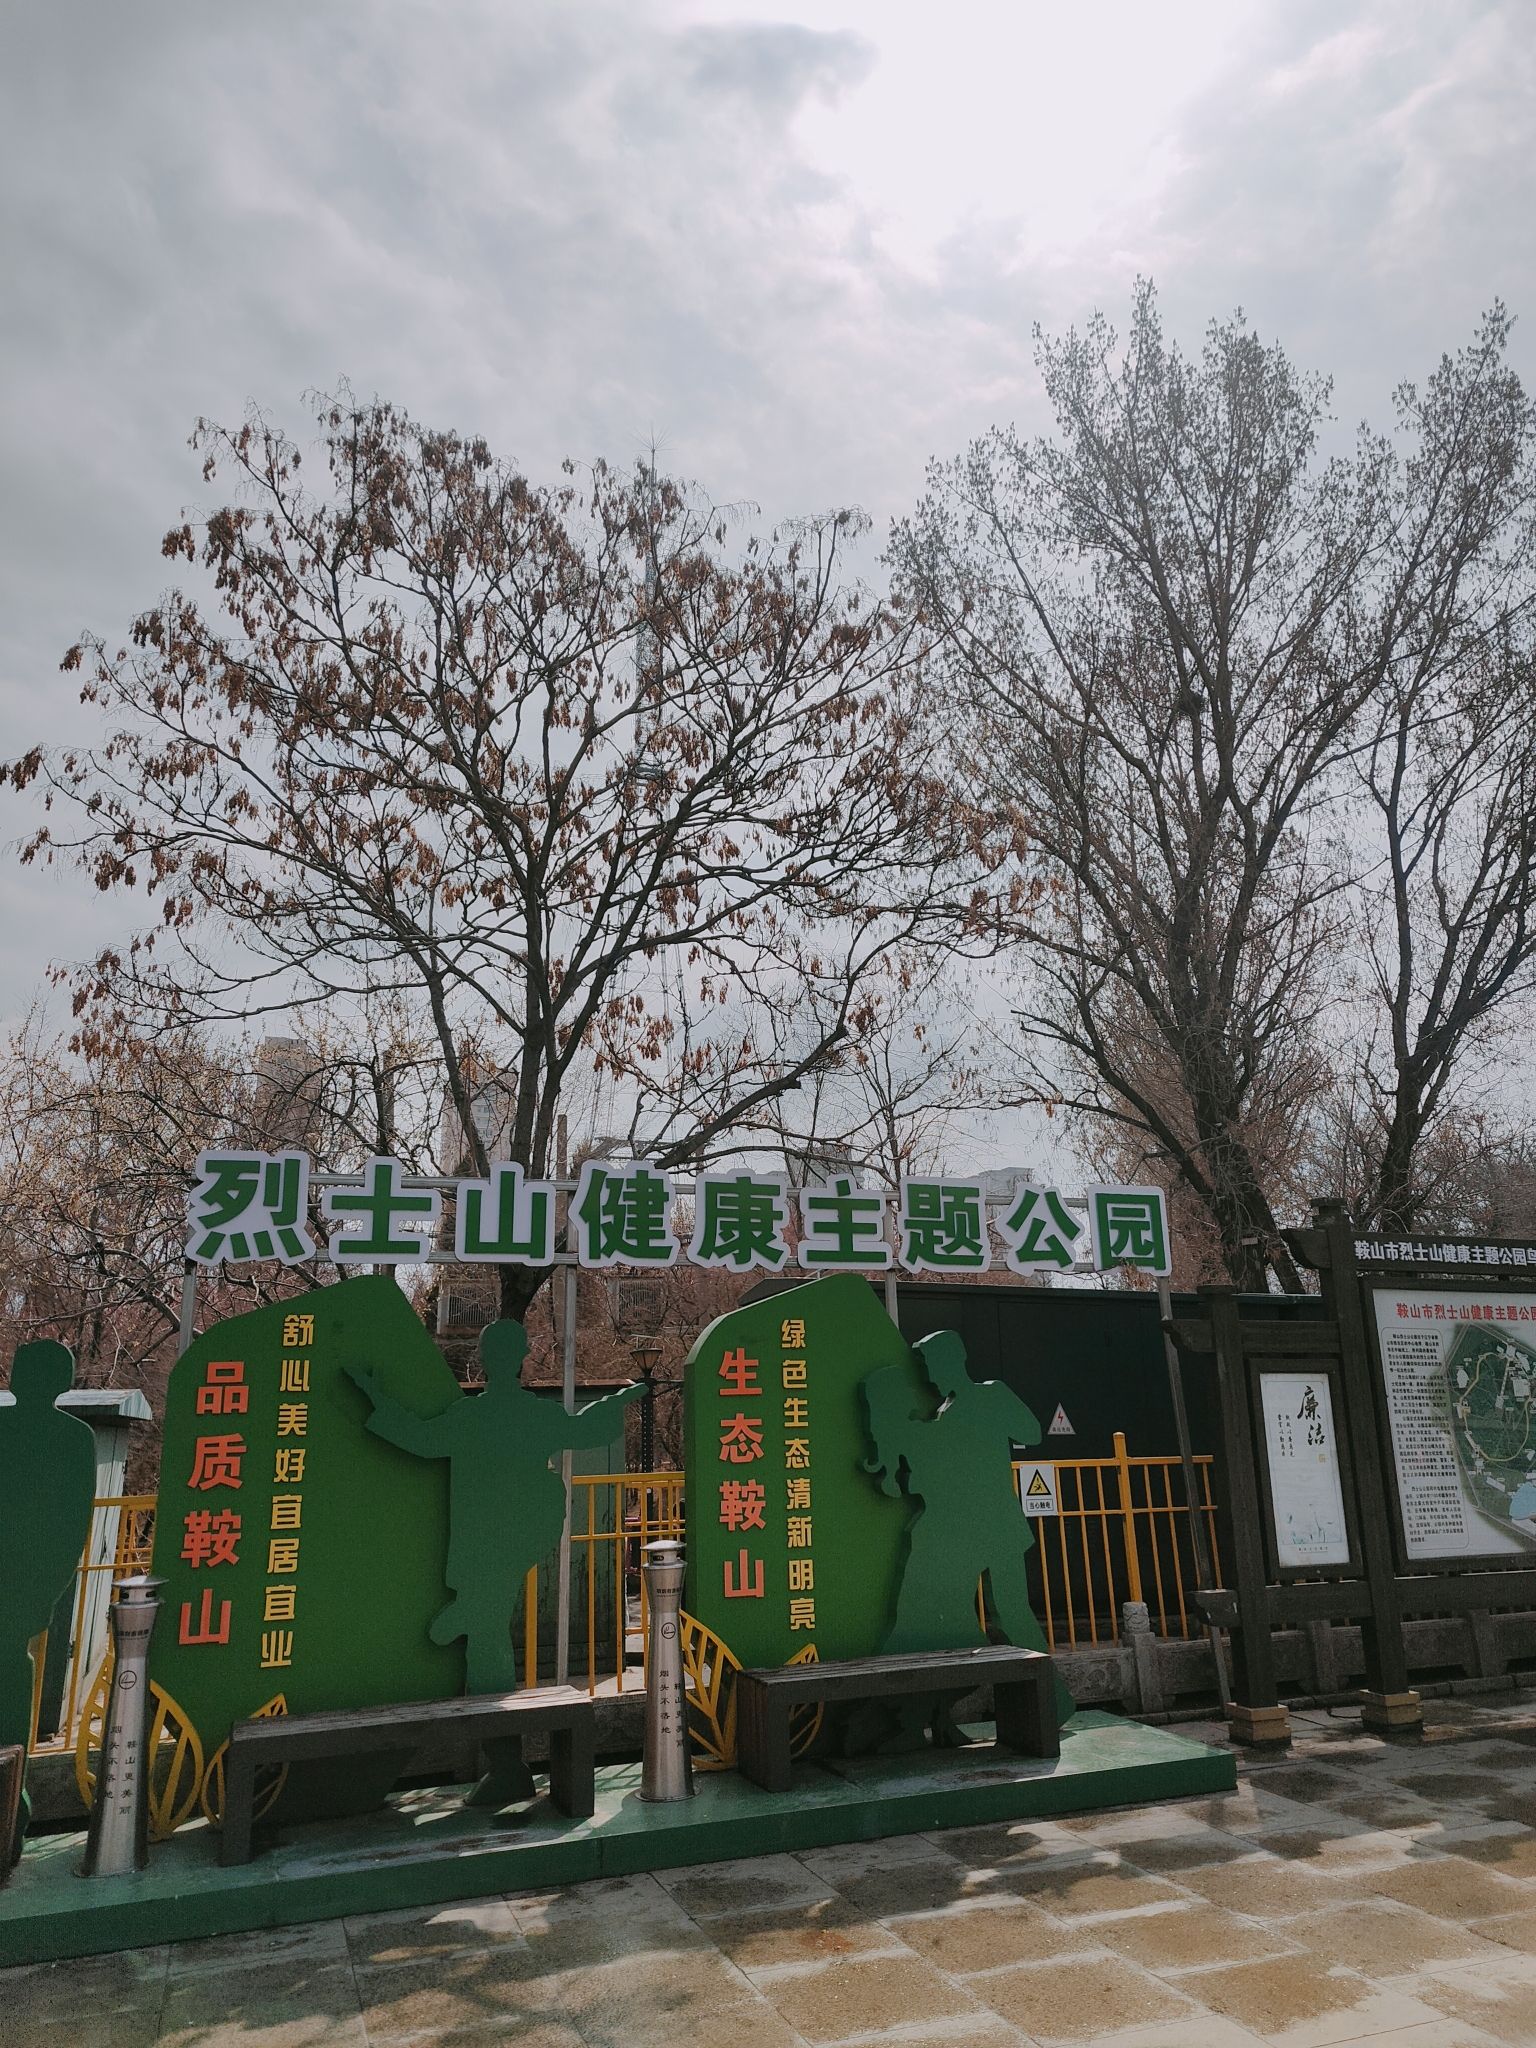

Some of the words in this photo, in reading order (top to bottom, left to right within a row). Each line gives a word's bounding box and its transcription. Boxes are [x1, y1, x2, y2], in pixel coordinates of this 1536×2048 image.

[194, 1159, 1166, 1271] 烈士山健康主题公园
[178, 1361, 250, 1646] 品质鞍山
[260, 1314, 315, 1668] 舒心美好宜居宜业
[718, 1347, 766, 1599] 生态鞍山
[780, 1319, 816, 1630] 绿色生态清新明亮
[1029, 1501, 1051, 1510] 当心触电
